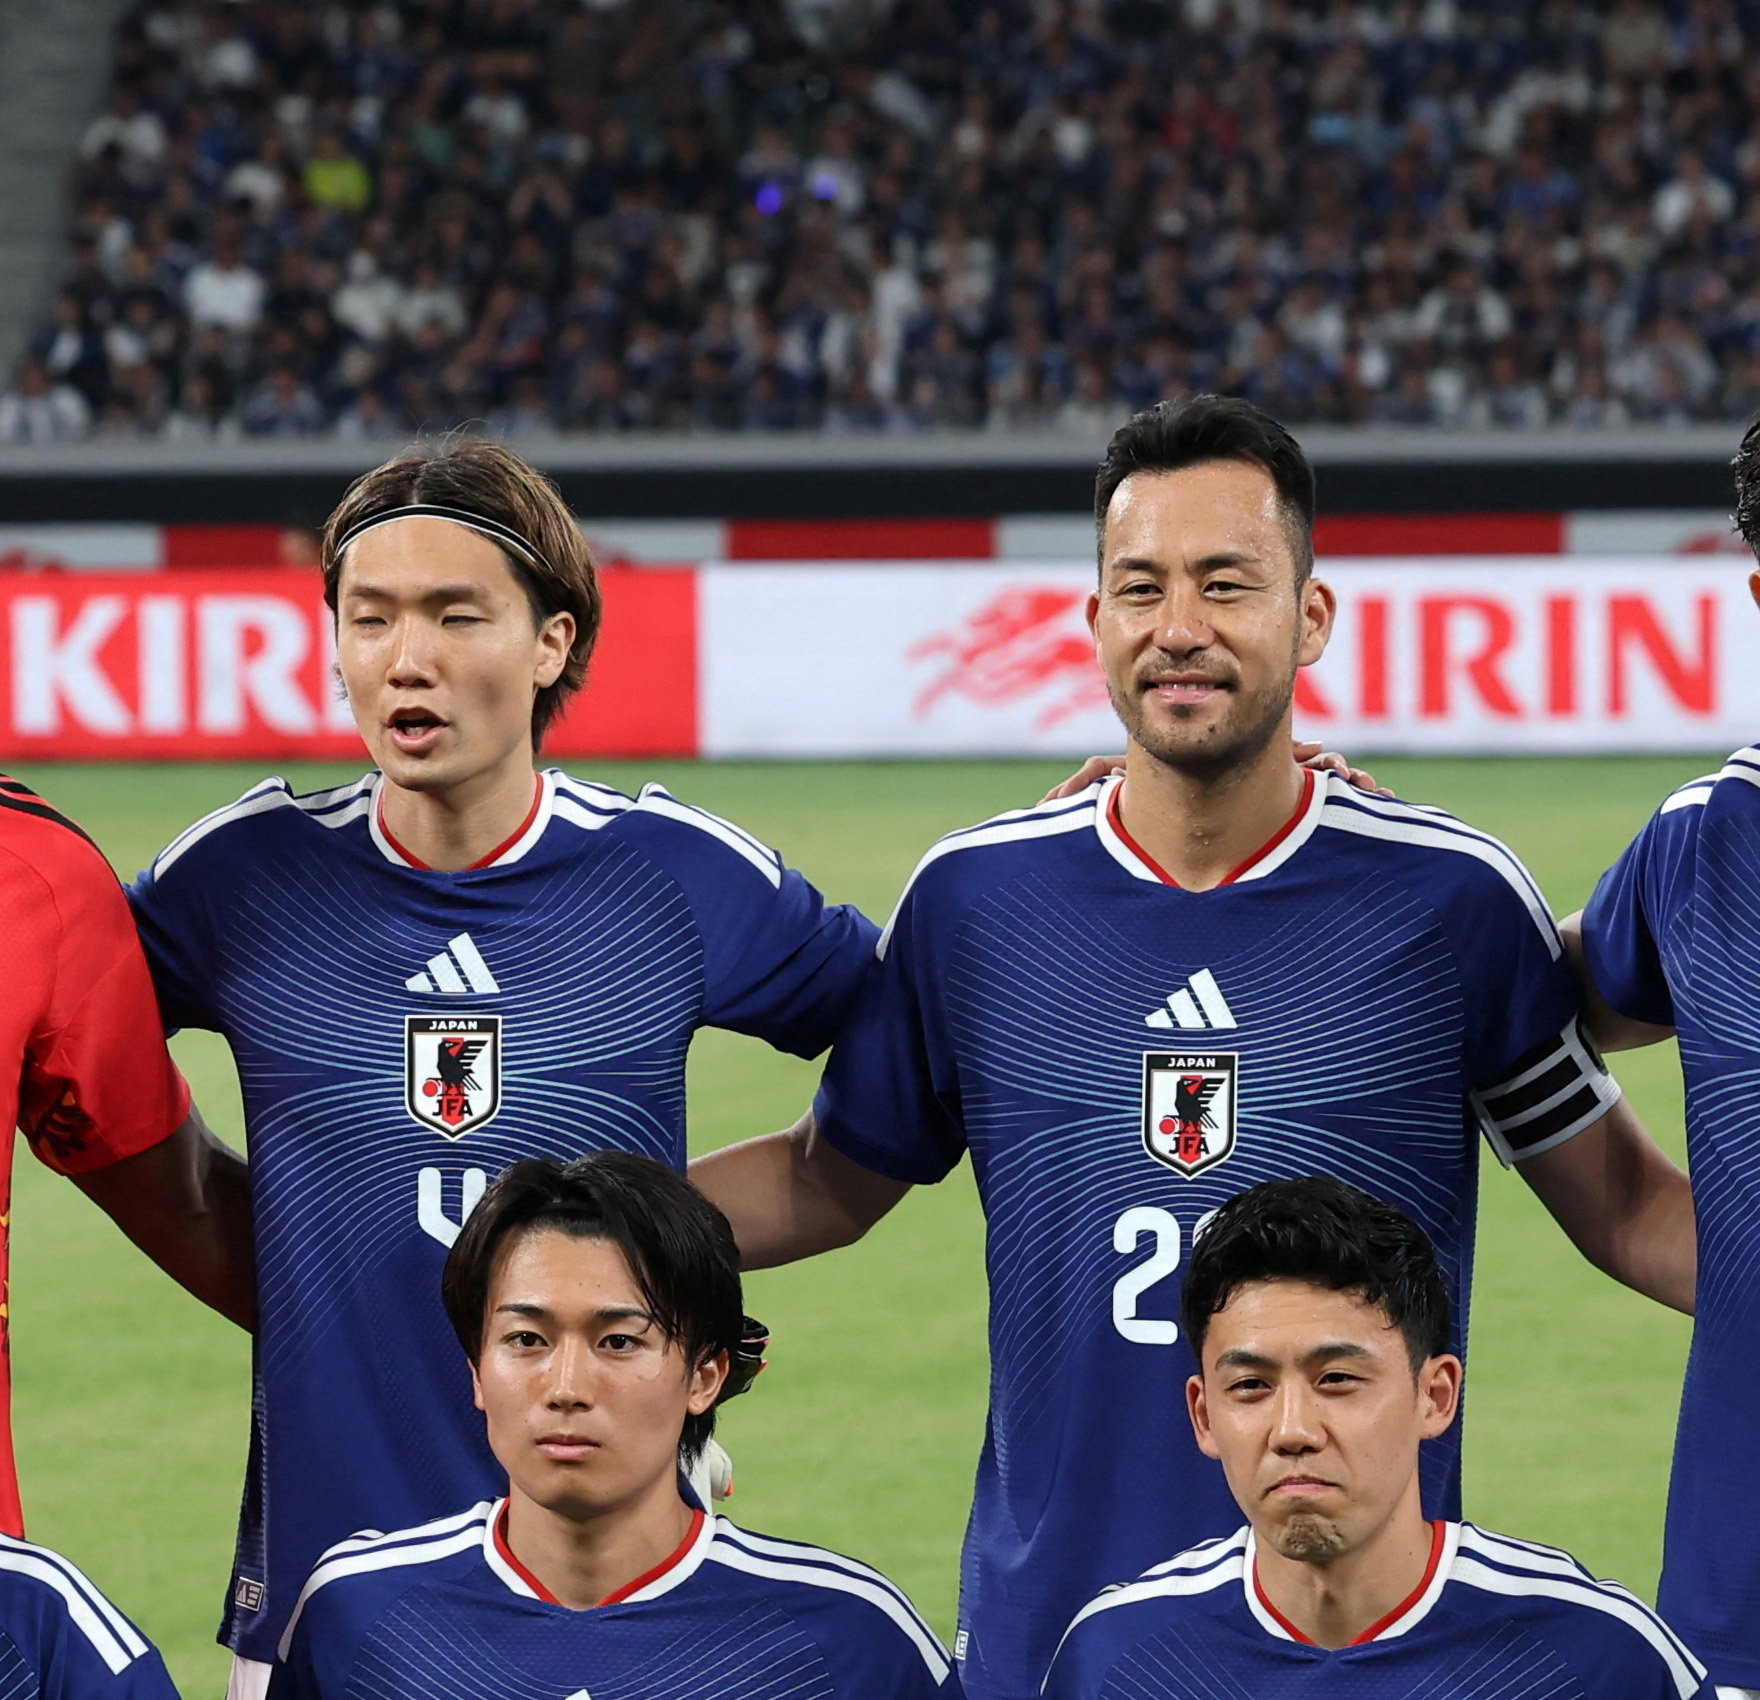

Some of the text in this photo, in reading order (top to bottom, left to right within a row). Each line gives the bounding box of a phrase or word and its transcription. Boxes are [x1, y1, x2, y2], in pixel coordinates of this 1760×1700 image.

[1295, 592, 1716, 720] IRIN
[429, 1020, 478, 1031] JAPAN
[1168, 1057, 1216, 1068] JAPAN
[432, 1098, 473, 1117] JFA
[1169, 1136, 1210, 1155] JFA
[1113, 1206, 1220, 1345] 2
